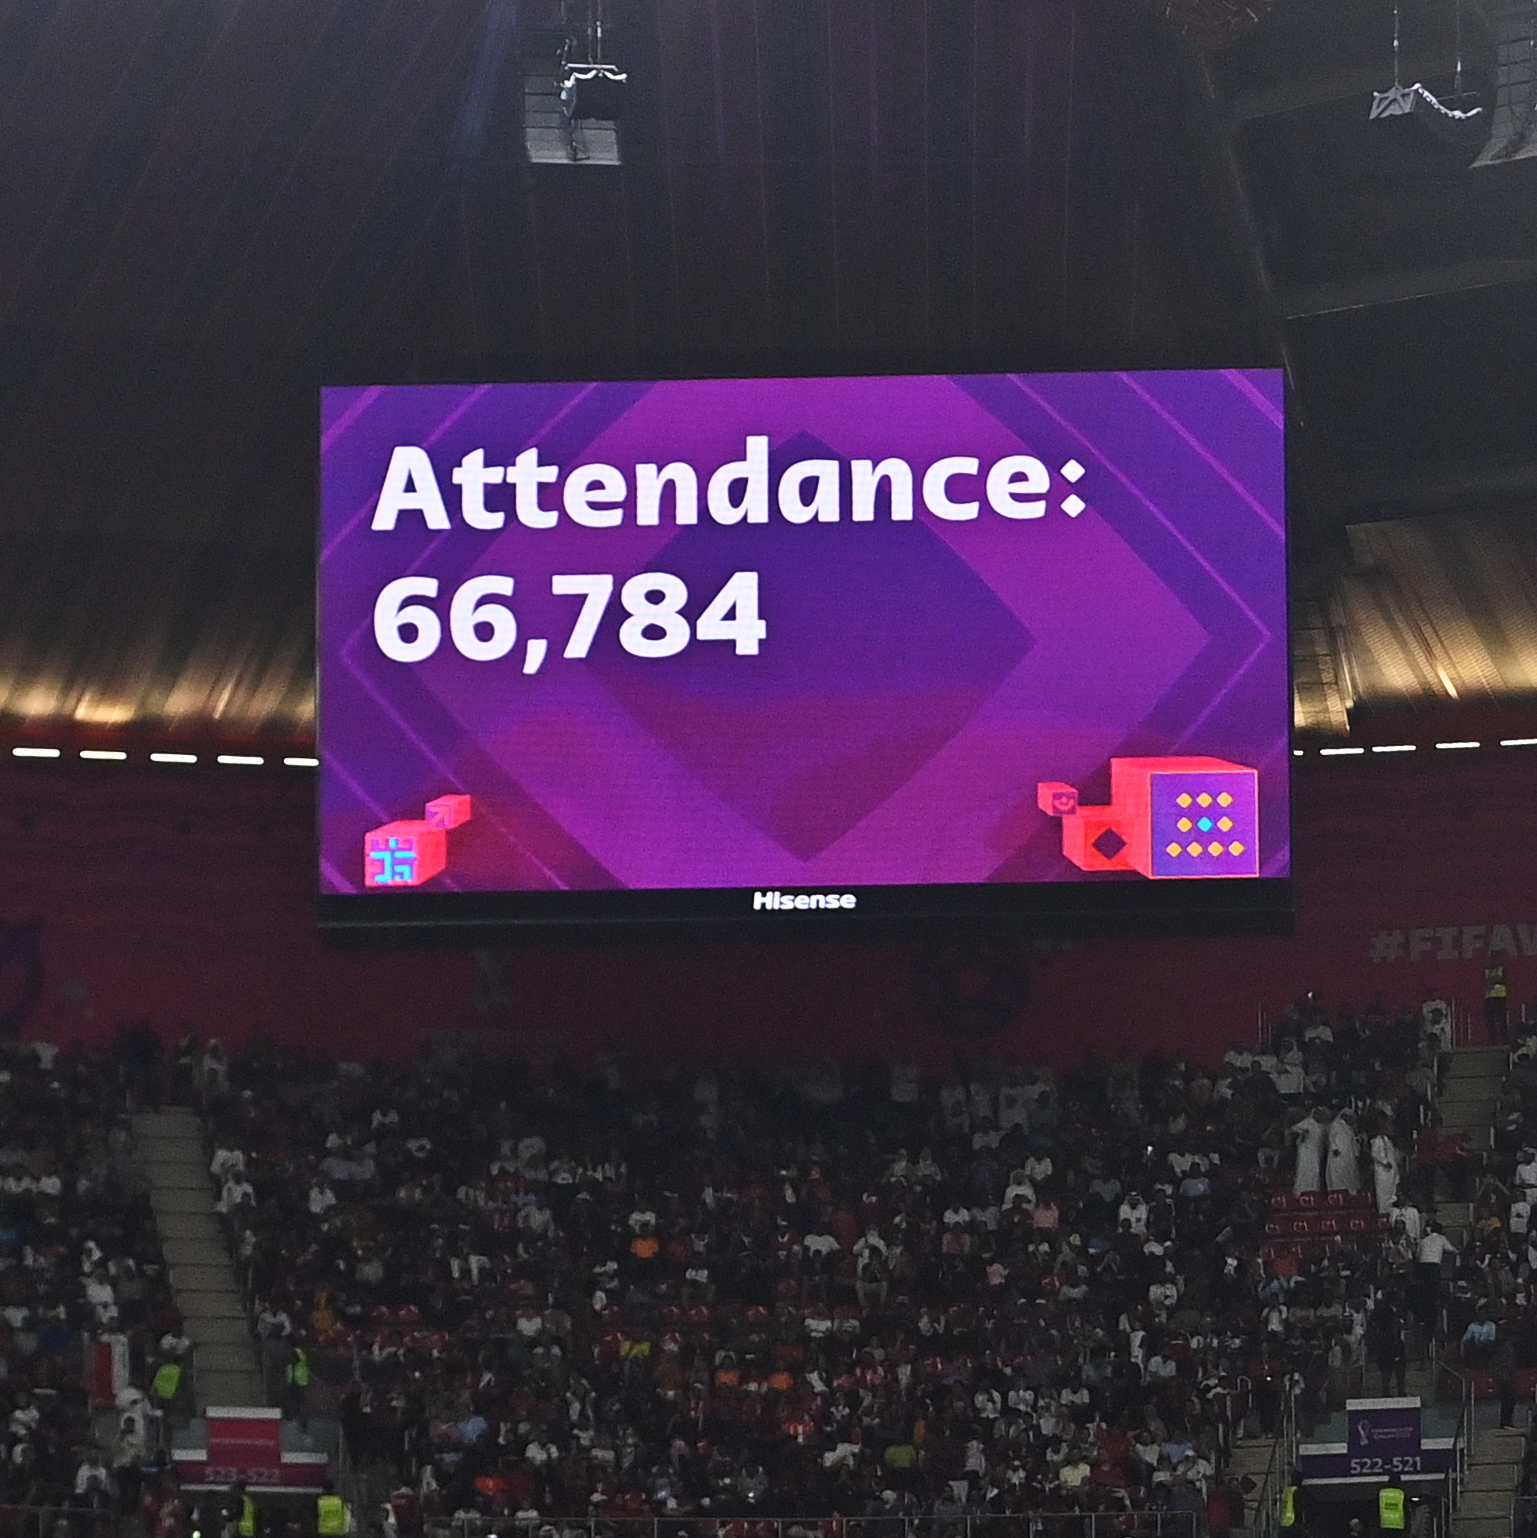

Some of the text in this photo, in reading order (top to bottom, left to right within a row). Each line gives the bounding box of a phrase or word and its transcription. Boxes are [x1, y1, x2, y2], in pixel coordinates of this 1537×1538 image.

[372, 436, 1085, 530] Attendance:
[374, 572, 766, 674] 66,784
[753, 892, 856, 910] Hisense
[1351, 1455, 1421, 1473] 522-521
